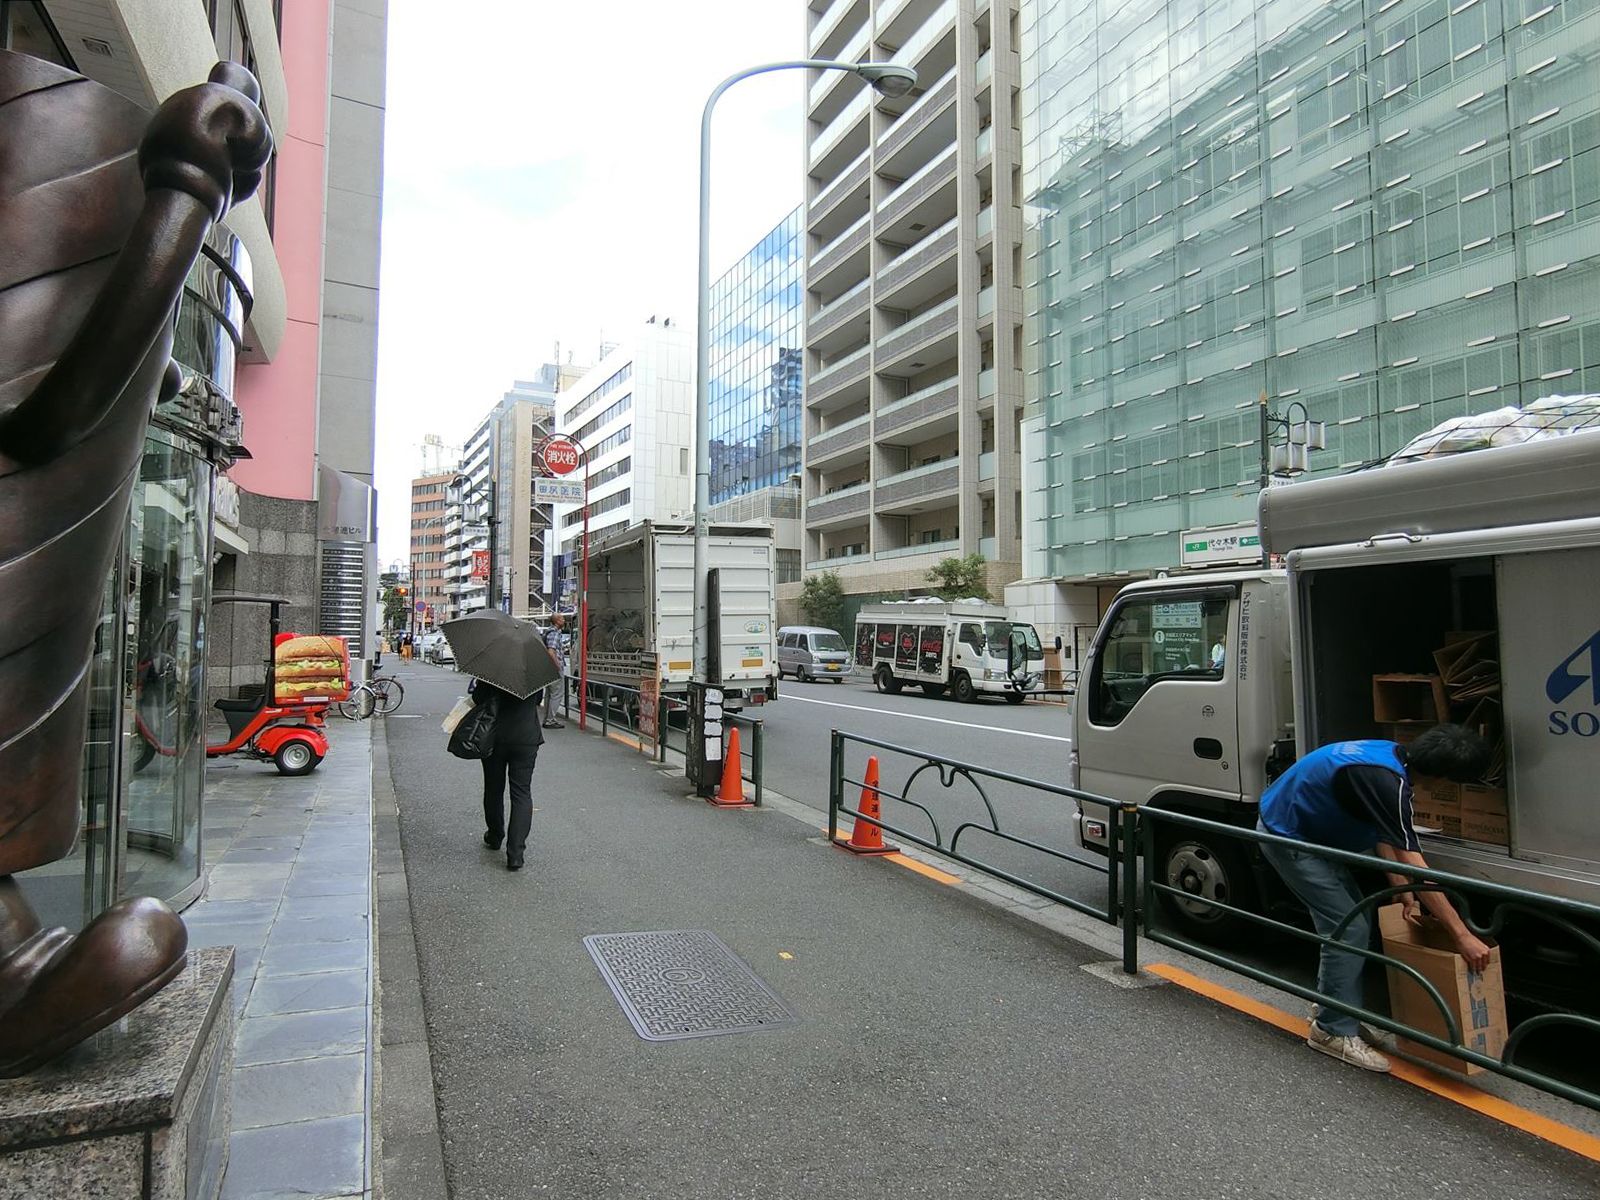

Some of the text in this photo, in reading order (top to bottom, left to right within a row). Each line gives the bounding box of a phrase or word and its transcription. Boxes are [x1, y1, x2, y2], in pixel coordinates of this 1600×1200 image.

[547, 449, 576, 466] 消火栓
[1208, 536, 1238, 548] 代々木駅
[1239, 591, 1251, 681] アサヒ飲料販売株式会社
